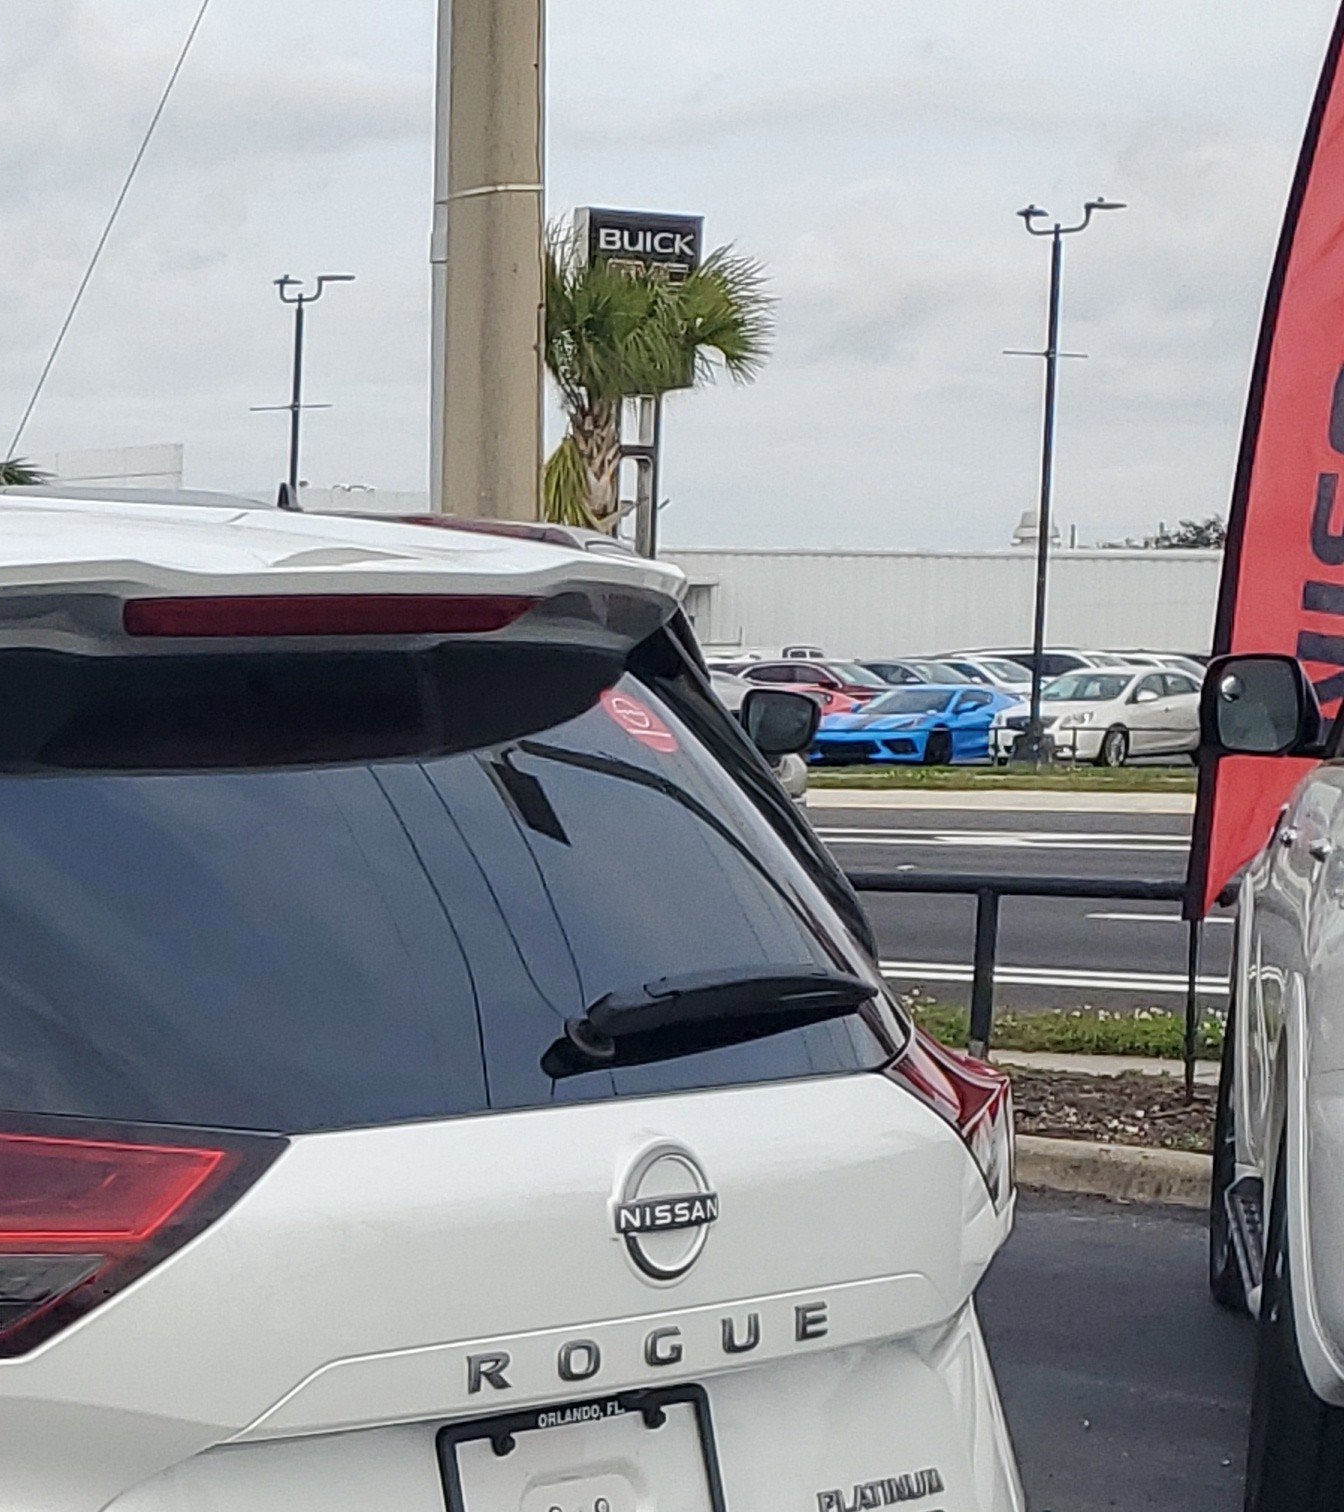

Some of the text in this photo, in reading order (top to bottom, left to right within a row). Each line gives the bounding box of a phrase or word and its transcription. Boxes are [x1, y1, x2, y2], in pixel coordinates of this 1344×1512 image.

[599, 228, 695, 256] BUICK
[619, 1197, 718, 1230] NISSAN
[466, 1300, 829, 1395] ROGUE
[538, 1404, 604, 1428] ORLANDO,
